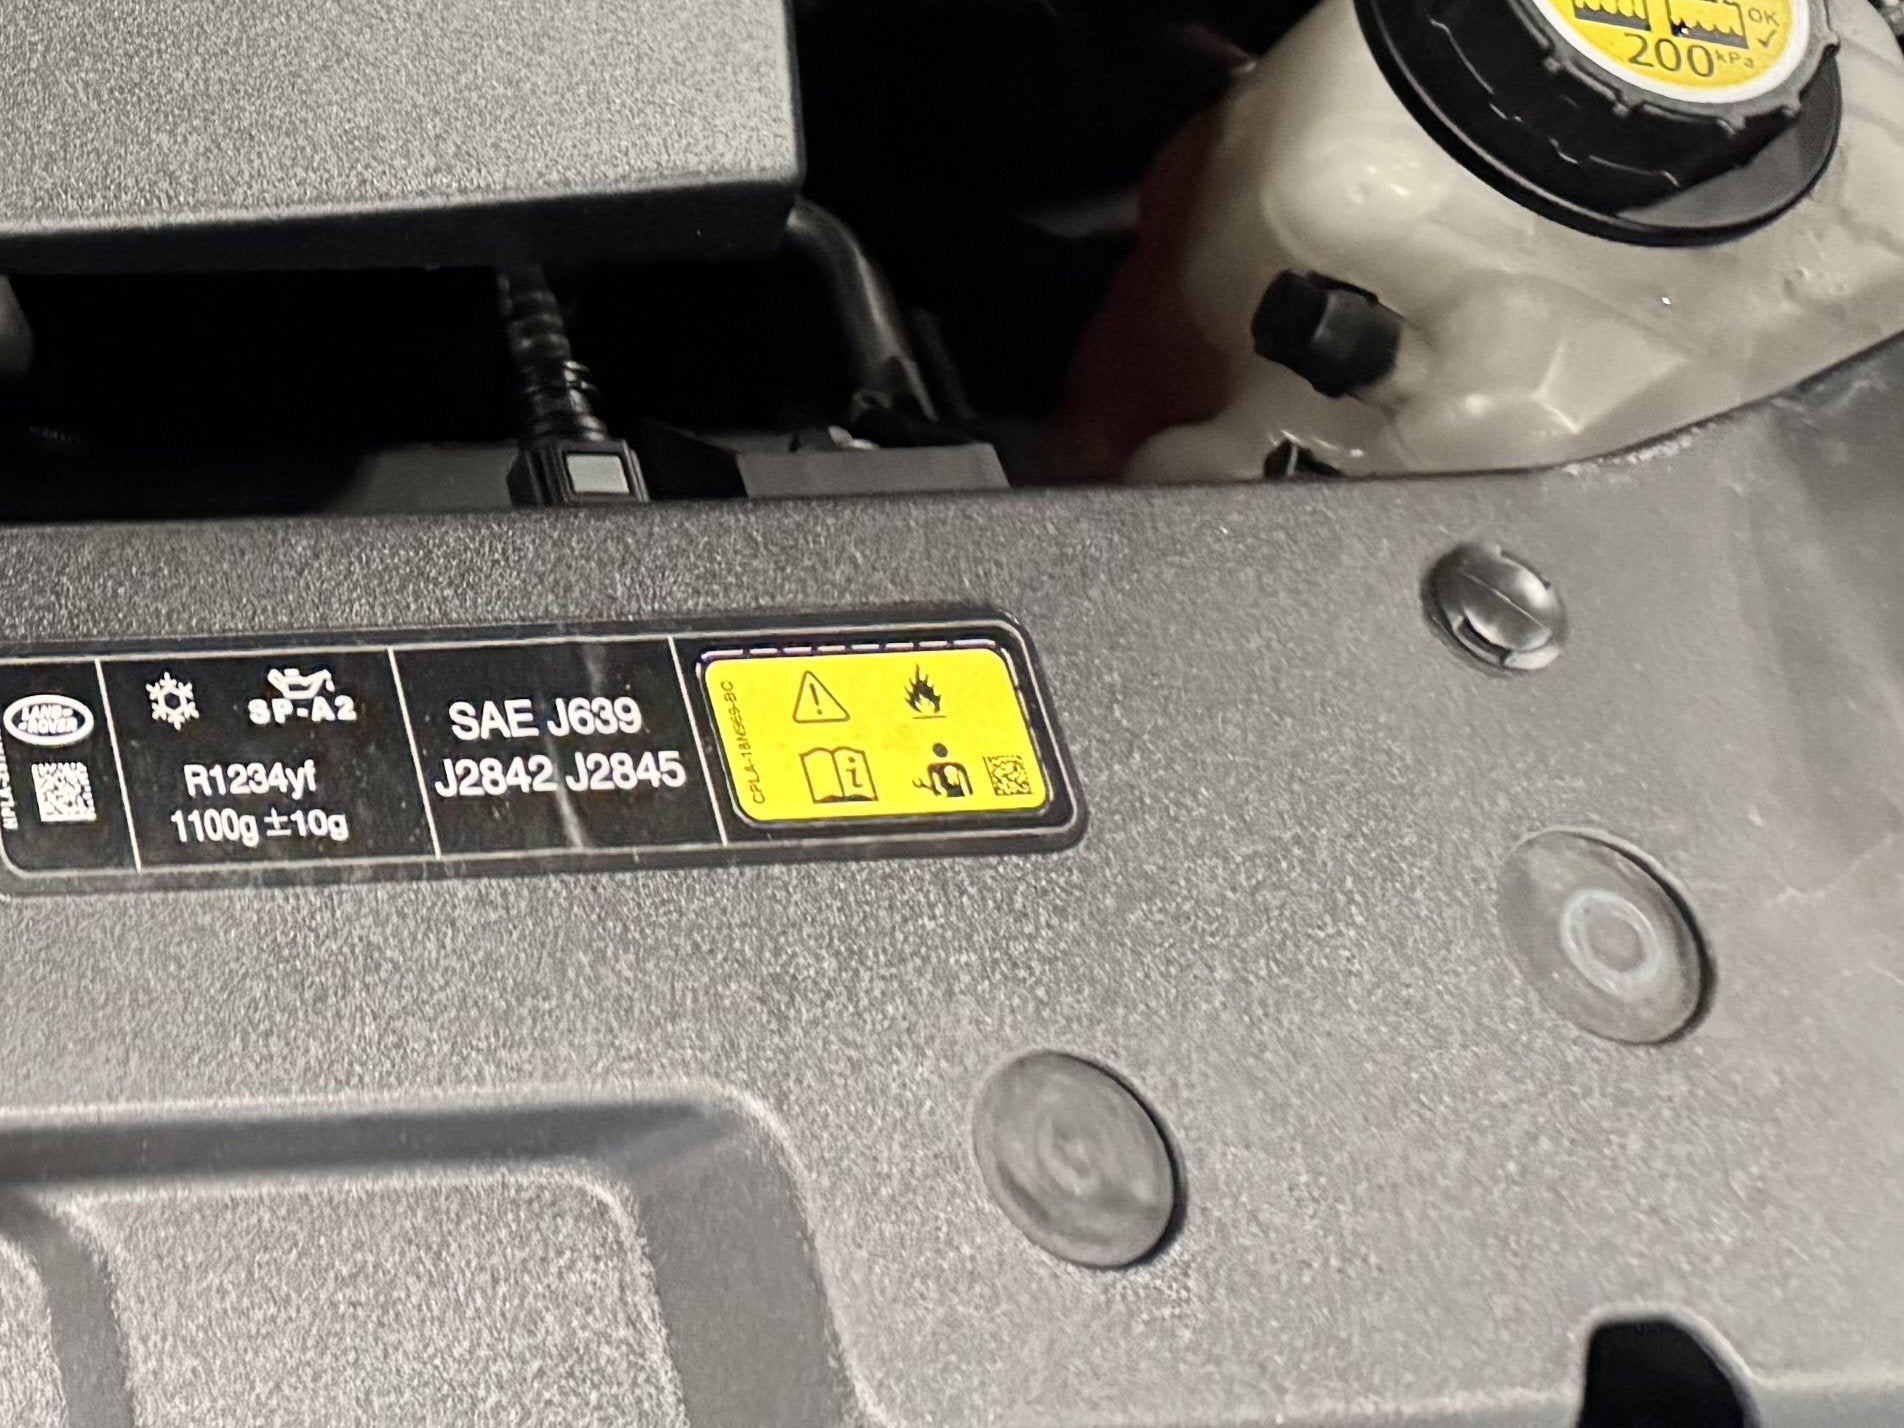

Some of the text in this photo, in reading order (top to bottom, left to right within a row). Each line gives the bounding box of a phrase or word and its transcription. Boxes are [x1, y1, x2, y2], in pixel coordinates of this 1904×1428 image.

[1748, 5, 1780, 29] OK
[1623, 32, 1756, 78] 200 kPa
[247, 696, 358, 725] SP-A2
[450, 696, 644, 742] SAE J639
[183, 758, 317, 801] R1234yf
[433, 749, 686, 798] J2842 J2845
[170, 804, 349, 847] 1100g ±10g
